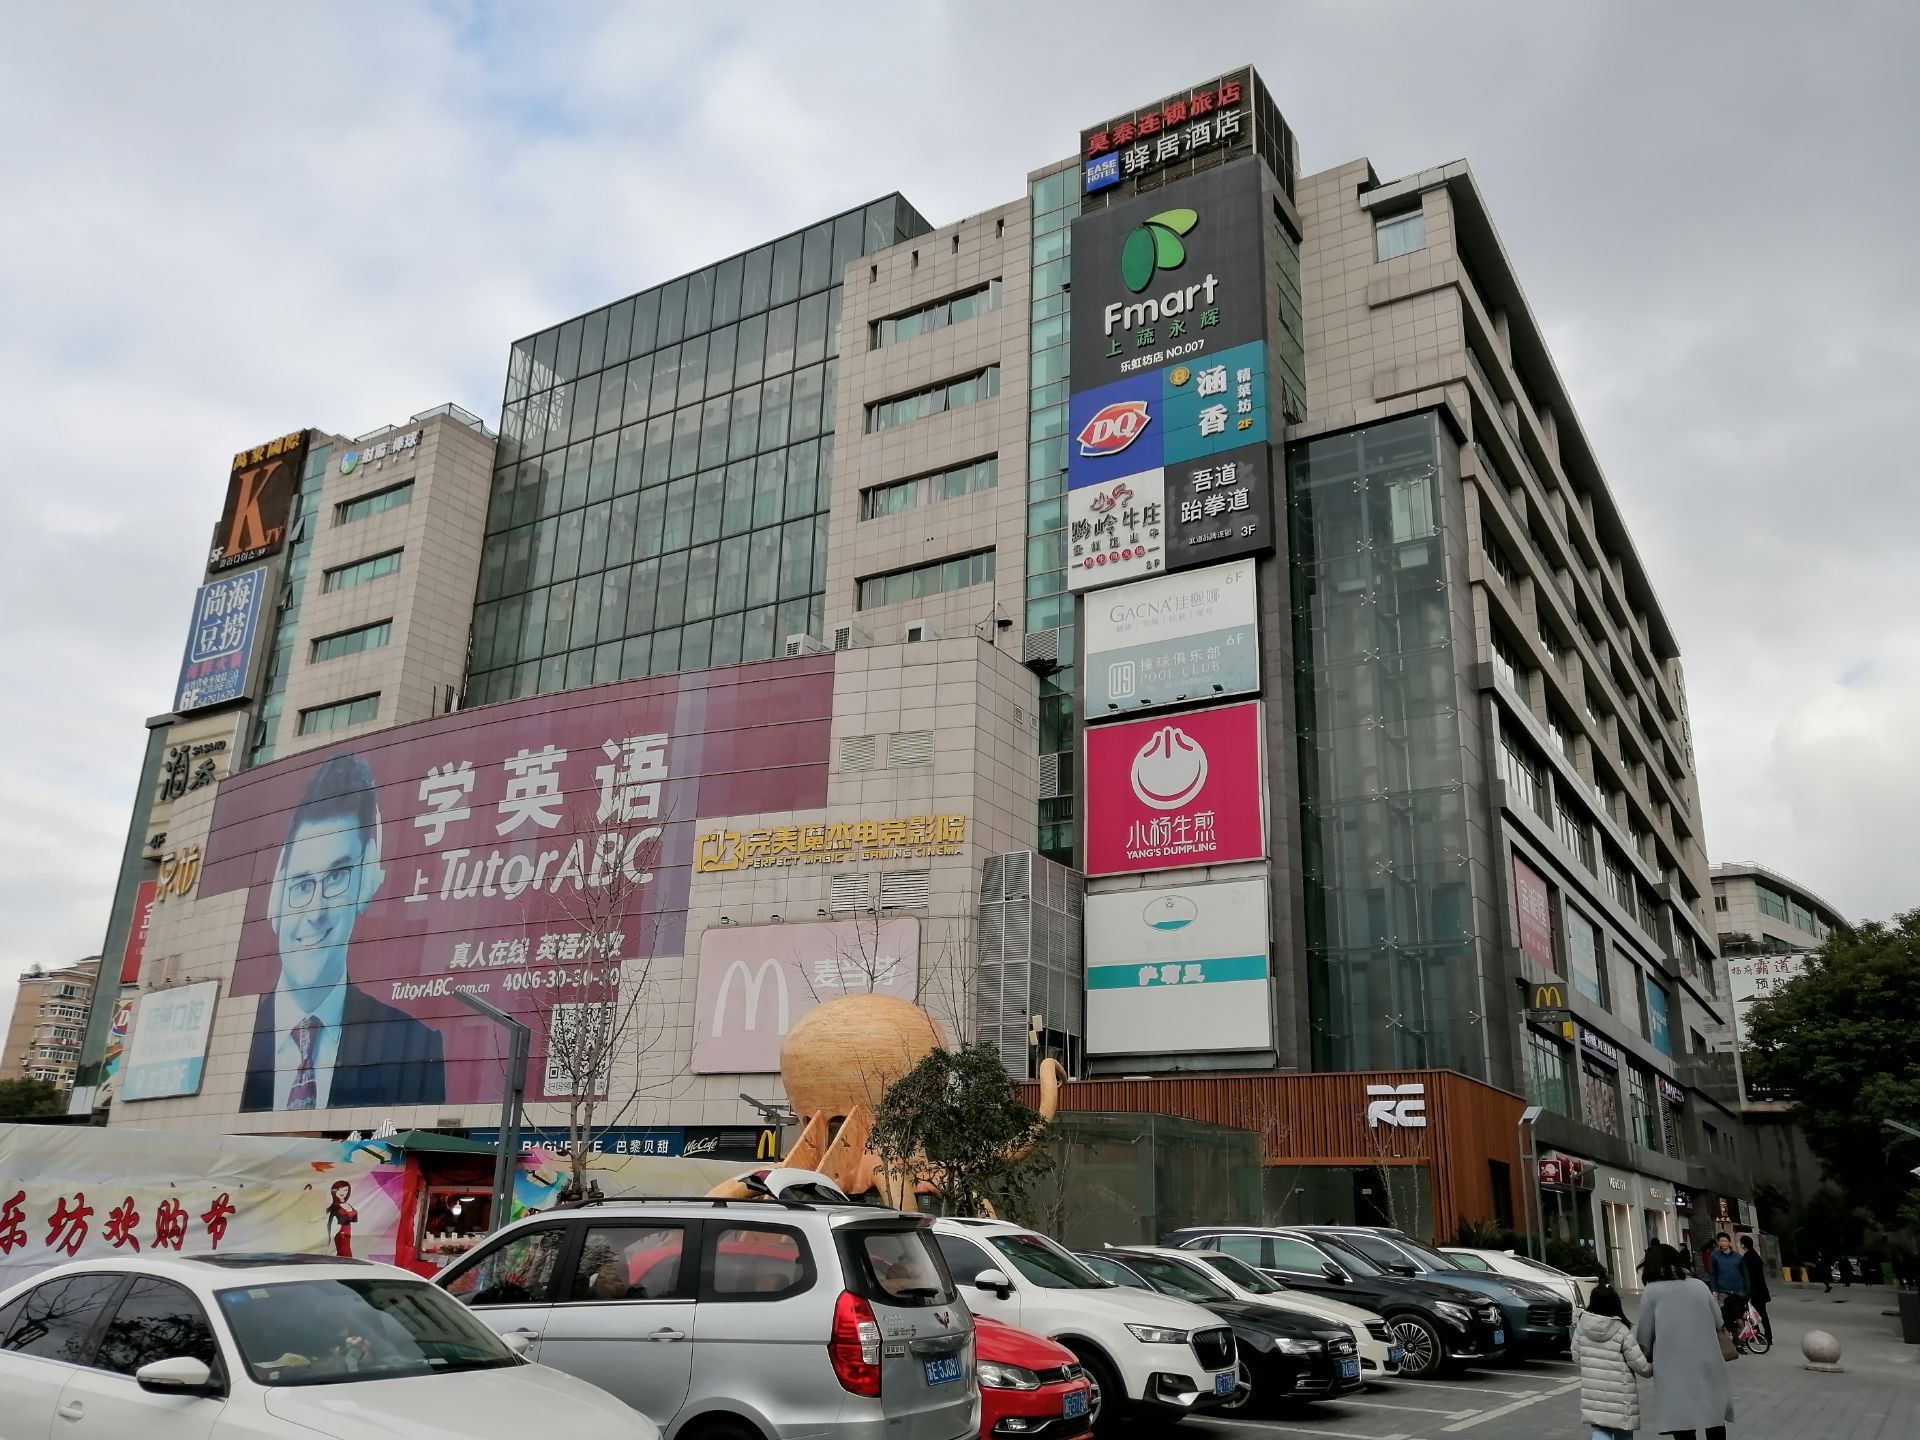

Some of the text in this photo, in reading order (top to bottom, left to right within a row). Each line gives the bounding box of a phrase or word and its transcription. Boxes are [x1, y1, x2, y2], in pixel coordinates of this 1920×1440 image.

[1123, 109, 1241, 174] 驿居酒店
[1087, 159, 1117, 177] EASE
[1087, 167, 1118, 184] HOTEL
[1104, 273, 1218, 336] Fmart
[1105, 308, 1220, 358] 上蔬永辉
[1120, 339, 1205, 373] 乐虹坊店 NO.007
[1197, 364, 1229, 438] 涵香
[1091, 411, 1138, 445] DQ
[1237, 418, 1254, 431] 2F
[1192, 463, 1238, 493] 吾道
[1181, 488, 1250, 524] 跆拳道
[1241, 524, 1256, 538] 3F
[1225, 571, 1244, 585] 6F
[203, 577, 252, 621] 尚海
[197, 611, 247, 654] 豆捞
[1227, 632, 1245, 646] 6F
[1182, 661, 1220, 678] CLUB
[179, 687, 201, 712] 6F
[414, 732, 669, 847] 学英语
[150, 832, 167, 849] 4F
[1126, 810, 1215, 848] 小杨生煎
[404, 827, 663, 903] 上 TutorABC
[746, 855, 800, 869] PERFECT
[804, 852, 844, 865] MAGIC
[862, 847, 912, 861] GAMING
[915, 844, 964, 857] CINEMA
[1126, 842, 1217, 859] YANG'S DUMPLING
[450, 938, 530, 969] 真人在线
[616, 1140, 669, 1154] 巴黎贝甜
